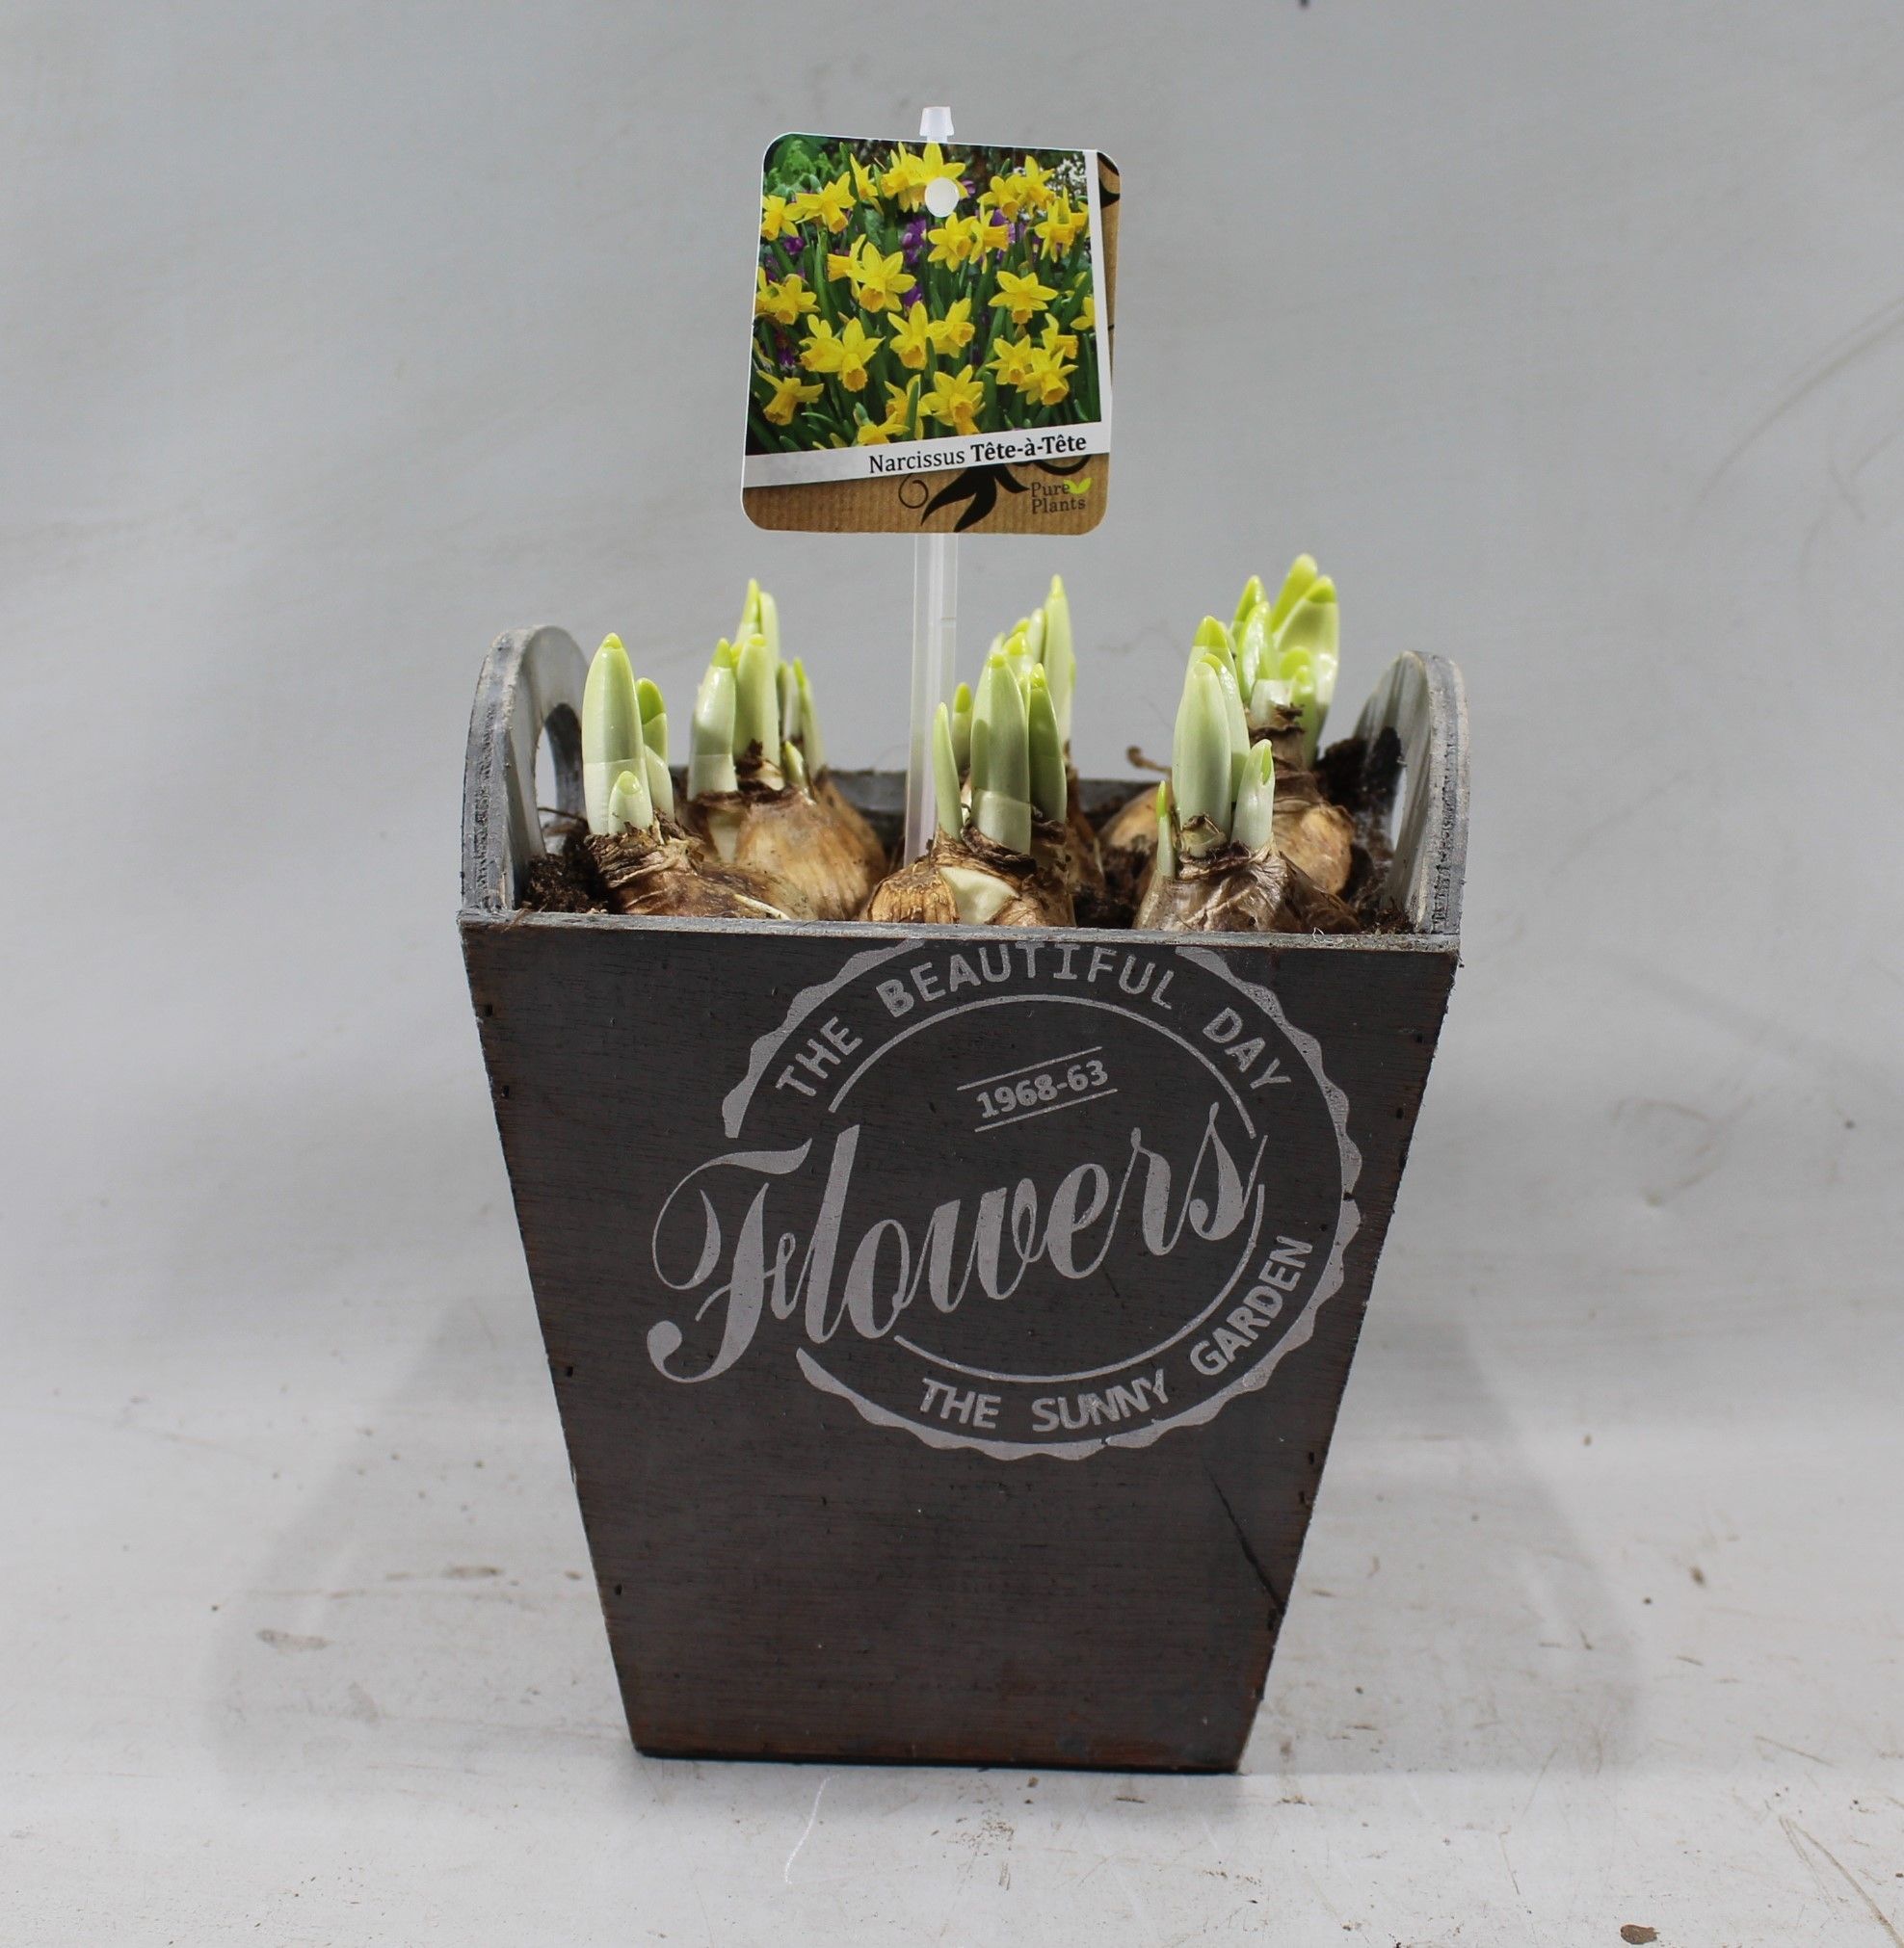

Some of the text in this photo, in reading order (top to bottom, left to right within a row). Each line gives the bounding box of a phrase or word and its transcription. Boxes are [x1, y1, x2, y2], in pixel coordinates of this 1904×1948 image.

[868, 434, 1087, 474] Narcissus Tête-à-Tête
[1030, 482, 1071, 498] Pure
[1032, 495, 1086, 514] Plants
[775, 941, 1292, 1098] THE BEAUTIFUL DAY
[975, 1059, 1109, 1119] 1968-63
[647, 1101, 1268, 1383] Flowers
[918, 1235, 1314, 1433] THE SUNNY GARDEN
